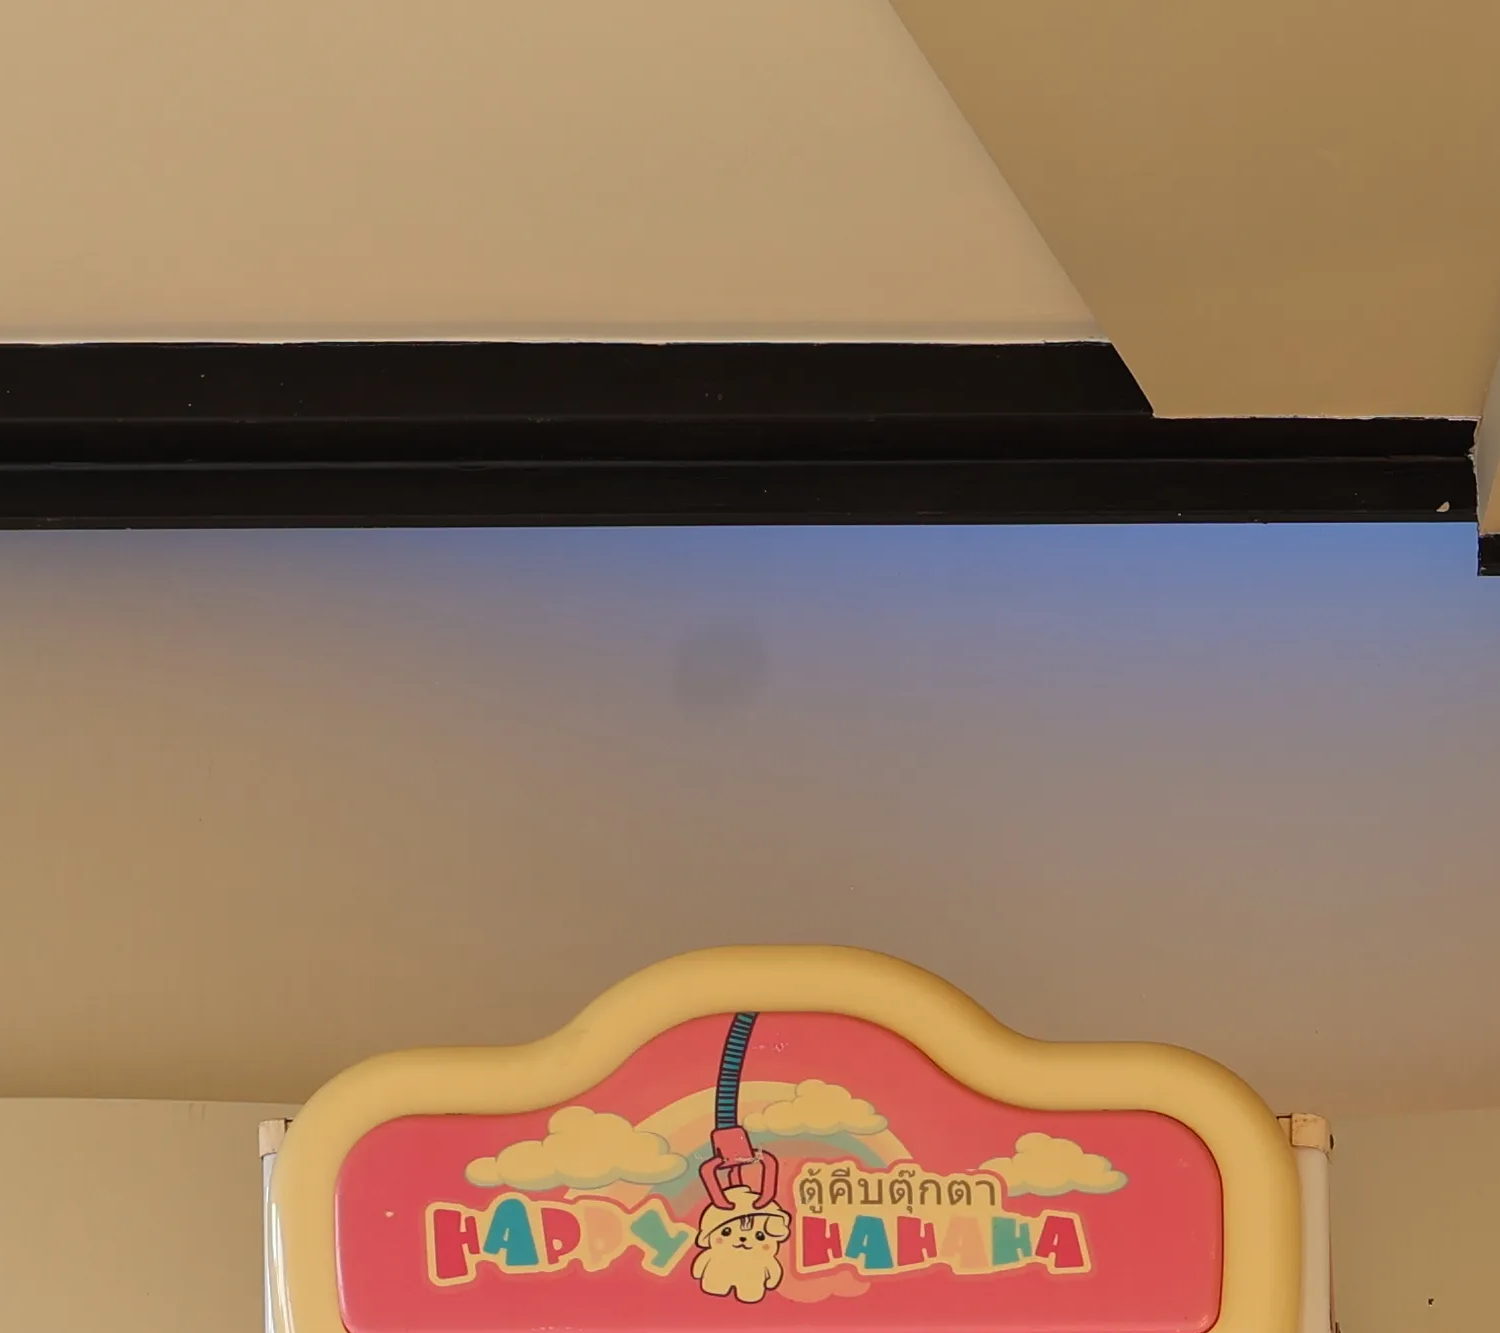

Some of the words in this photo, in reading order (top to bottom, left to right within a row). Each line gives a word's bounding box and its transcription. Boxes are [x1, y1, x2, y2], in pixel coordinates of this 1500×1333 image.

[799, 1167, 997, 1214] ตู้คีบตุ๊กตา
[432, 1198, 690, 1280] HAPPY
[802, 1214, 1085, 1270] HAHAHA
